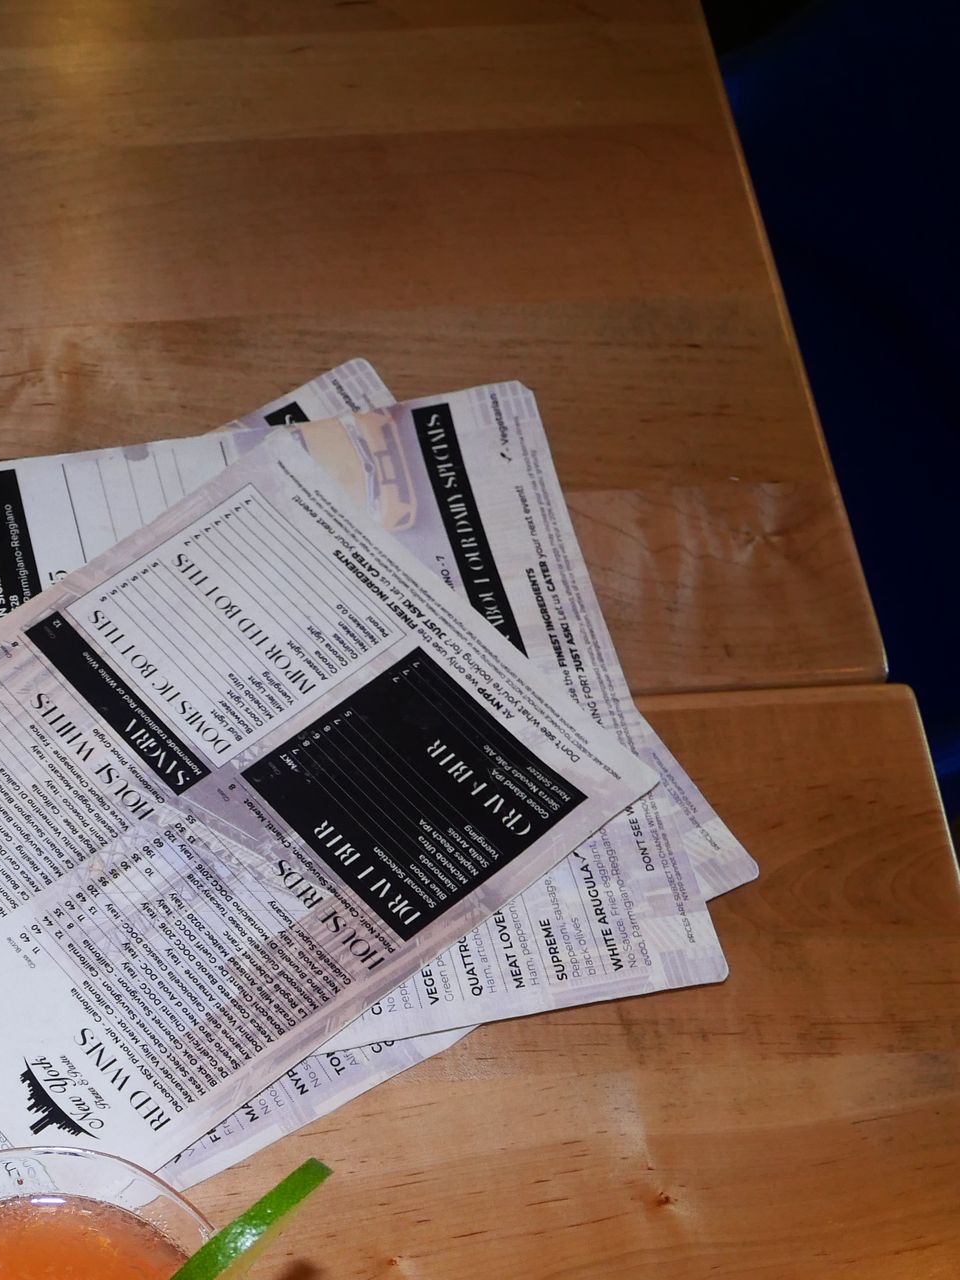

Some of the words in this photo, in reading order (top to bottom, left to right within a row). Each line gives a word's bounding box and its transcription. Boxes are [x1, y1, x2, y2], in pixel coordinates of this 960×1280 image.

[332, 548, 390, 602] INGREDIENTS
[385, 600, 419, 630] FINEST
[416, 627, 433, 643] the
[82, 651, 100, 670] Wine
[286, 639, 306, 659] Light
[431, 641, 448, 657] use
[302, 656, 329, 681] Amstel
[446, 655, 466, 674] only
[97, 667, 118, 689] White
[115, 686, 125, 695] or
[227, 672, 245, 691] Ultra
[464, 672, 479, 687] we
[121, 693, 138, 709] Red
[243, 688, 275, 720] Michelob
[476, 686, 504, 711] NYPP
[133, 706, 168, 740] traditional
[209, 708, 230, 728] Light
[501, 707, 515, 719] At
[32, 692, 95, 762] WHITES
[91, 727, 112, 749] Grigio
[225, 726, 244, 742] Bud
[109, 746, 129, 767] Pinot
[165, 738, 203, 776] Homemade
[126, 763, 166, 804] Chardonnay,
[490, 767, 506, 782] IPA
[94, 762, 155, 821] HOUSE
[502, 778, 528, 801] Island
[242, 797, 267, 823] Merlot
[525, 797, 550, 820] Goose
[264, 819, 294, 849] Chianti,
[418, 818, 433, 833] IPA
[431, 830, 456, 854] Beach
[291, 845, 329, 887] Sauvignon,
[372, 845, 406, 879] Selection
[408, 863, 431, 885] Moon
[453, 851, 479, 877] Naples
[273, 855, 324, 910] REDS
[402, 876, 437, 909] Seasonal
[428, 882, 448, 901] Blue
[579, 863, 609, 925] ARUGULA
[325, 883, 360, 918] Cabernet
[358, 914, 377, 935] Noir,
[320, 907, 385, 971] HOUSE
[373, 931, 397, 954] Pinot
[538, 918, 568, 981] SUPREME
[600, 927, 624, 972] WHITE
[66, 942, 99, 978] California
[69, 986, 103, 1023] California
[101, 980, 138, 1021] Sauvignon
[104, 1026, 122, 1045] Noir
[135, 1018, 168, 1054] Cabernet
[79, 1027, 131, 1092] WINES
[118, 1041, 140, 1065] Pinot
[165, 1051, 190, 1078] Select
[26, 1056, 77, 1094] York
[59, 1055, 83, 1083] Pasta
[135, 1064, 155, 1081] RSV
[77, 1078, 89, 1086] &
[186, 1075, 207, 1097] Hess
[87, 1086, 111, 1109] Pizza
[151, 1078, 184, 1113] DeLoach
[69, 1095, 105, 1137] New
[129, 1090, 171, 1132] RED
